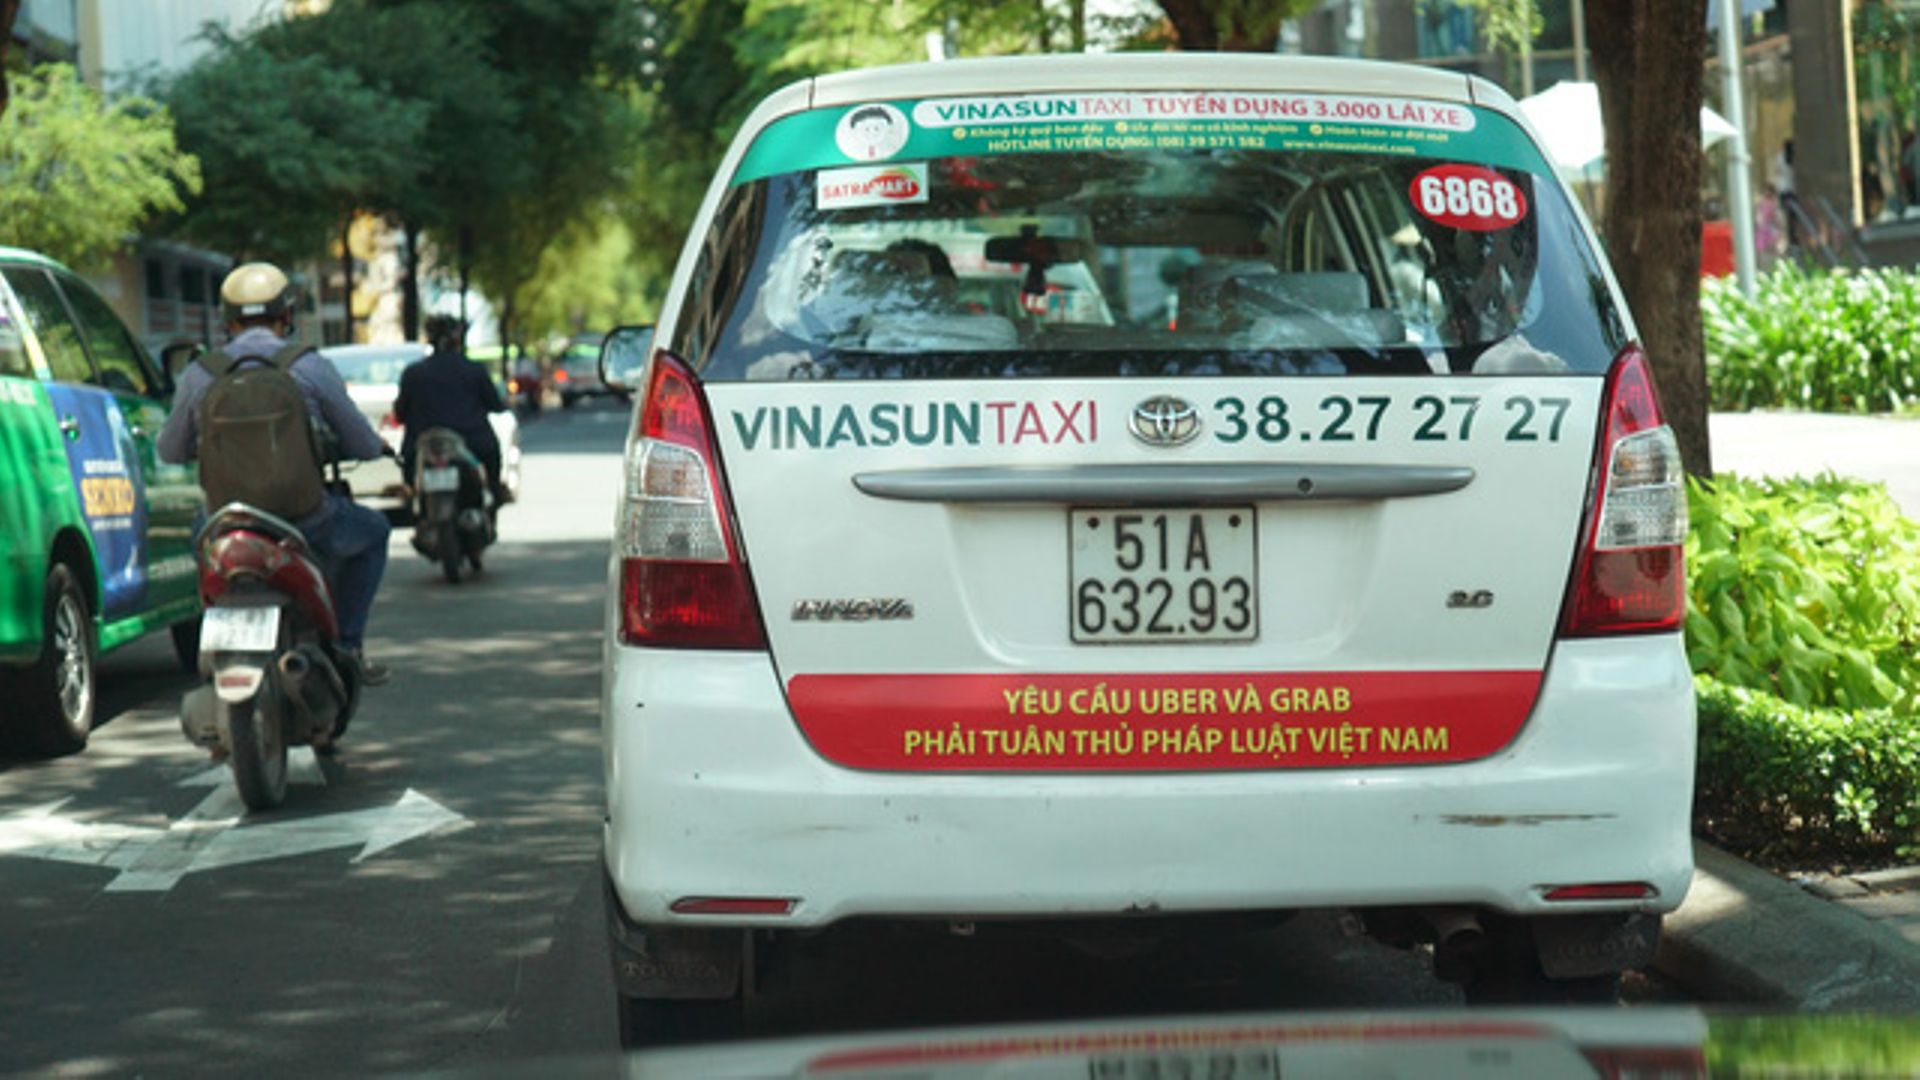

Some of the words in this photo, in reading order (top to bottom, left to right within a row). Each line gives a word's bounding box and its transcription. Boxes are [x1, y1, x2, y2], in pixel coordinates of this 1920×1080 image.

[1143, 92, 1227, 114] TUYỂN
[1233, 97, 1308, 118] DỤNG
[1314, 101, 1381, 119] 3.000
[1387, 101, 1426, 122] LÁI
[1432, 106, 1461, 125] XE
[988, 139, 1051, 151] HOTLINE
[1157, 136, 1185, 147] (08)
[1189, 136, 1206, 147] 39
[1420, 175, 1518, 219] 6868
[1213, 396, 1392, 443] 38.27
[1412, 396, 1480, 442] 27
[1503, 396, 1572, 443] 27
[1113, 514, 1211, 572] 51A
[1077, 577, 1252, 635] 632.93
[1004, 686, 1061, 714] YÊU
[1069, 682, 1132, 714] CẦU
[1140, 688, 1217, 714] UBER
[1223, 683, 1263, 712] VÀ
[1270, 688, 1350, 712] GRAB
[904, 722, 975, 754] PHẢI
[982, 723, 1065, 754] TUÂN
[1072, 721, 1134, 754] THỦ
[1142, 723, 1223, 753] PHÁP
[1231, 722, 1302, 759] LUẬT
[1309, 722, 1372, 759] VIỆT
[1381, 727, 1449, 752] NAM
